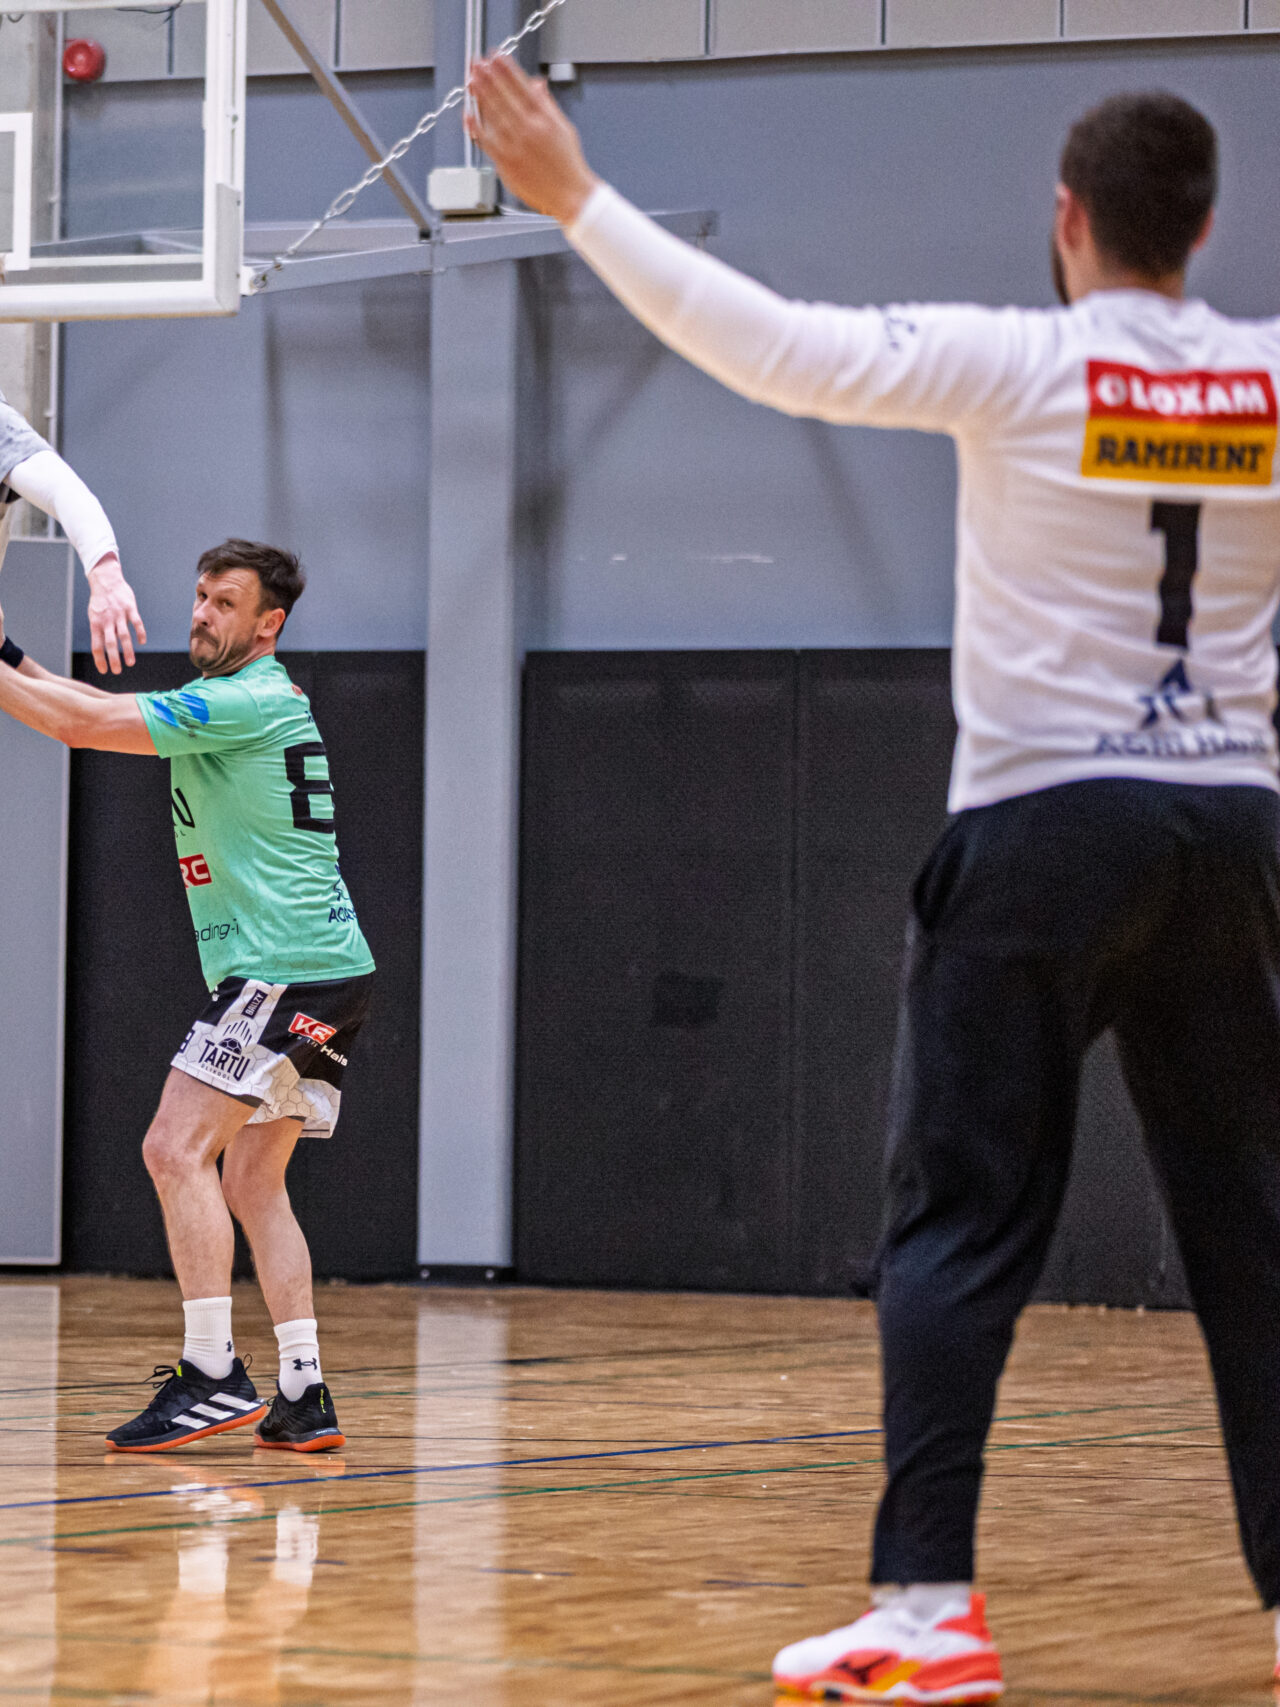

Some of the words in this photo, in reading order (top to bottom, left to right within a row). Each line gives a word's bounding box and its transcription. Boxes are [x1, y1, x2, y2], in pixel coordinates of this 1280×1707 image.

[1129, 373, 1269, 416] LOXAM
[1096, 434, 1265, 474] RAMIRENT
[1150, 501, 1201, 650] 1
[179, 858, 211, 888] RC
[198, 1038, 251, 1081] TARTU
[320, 1045, 348, 1066] Hals
